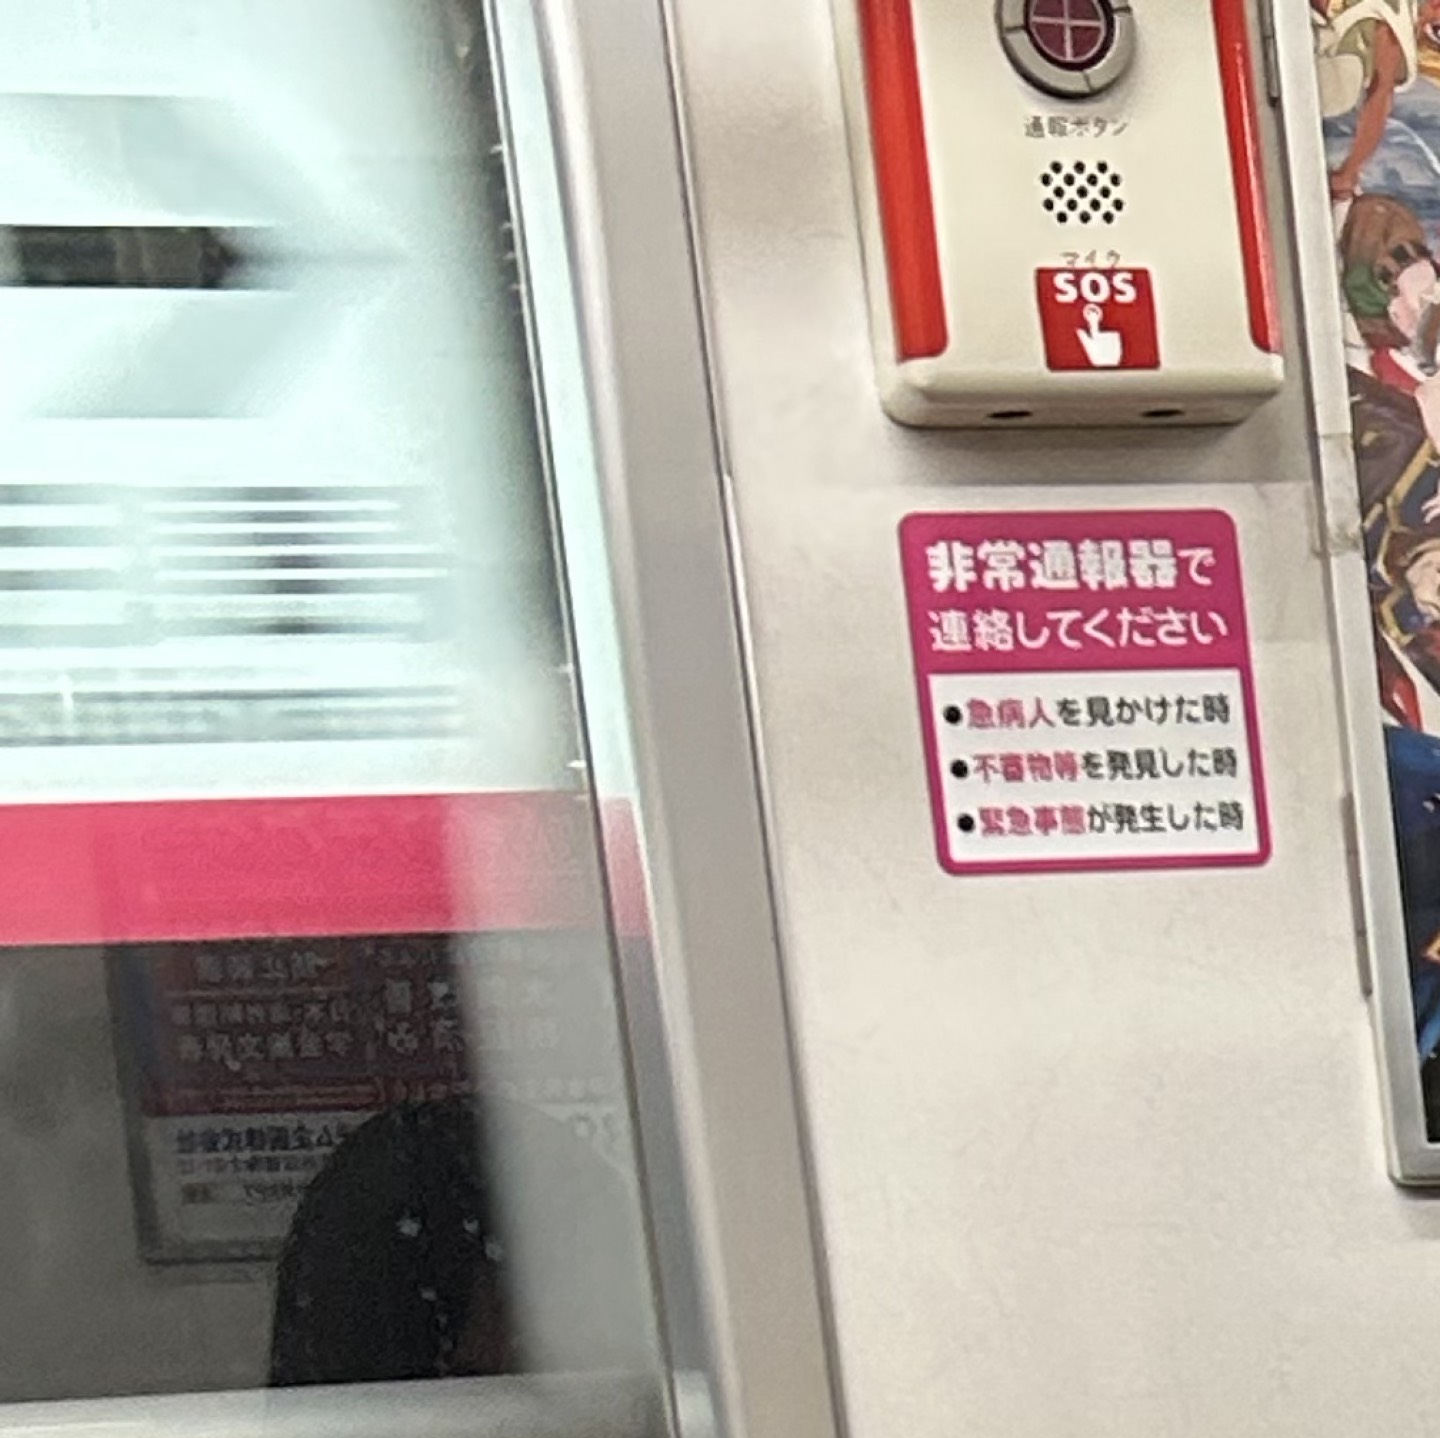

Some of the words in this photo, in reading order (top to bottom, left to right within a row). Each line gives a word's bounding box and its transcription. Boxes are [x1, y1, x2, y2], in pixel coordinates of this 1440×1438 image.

[1053, 271, 1138, 304] SOS
[926, 538, 1216, 592] 非常通報器で
[928, 606, 1229, 651] 連絡してください
[966, 693, 1231, 730] 急病人を見かけた時
[978, 800, 1245, 838] 緊急事態が発生した時
